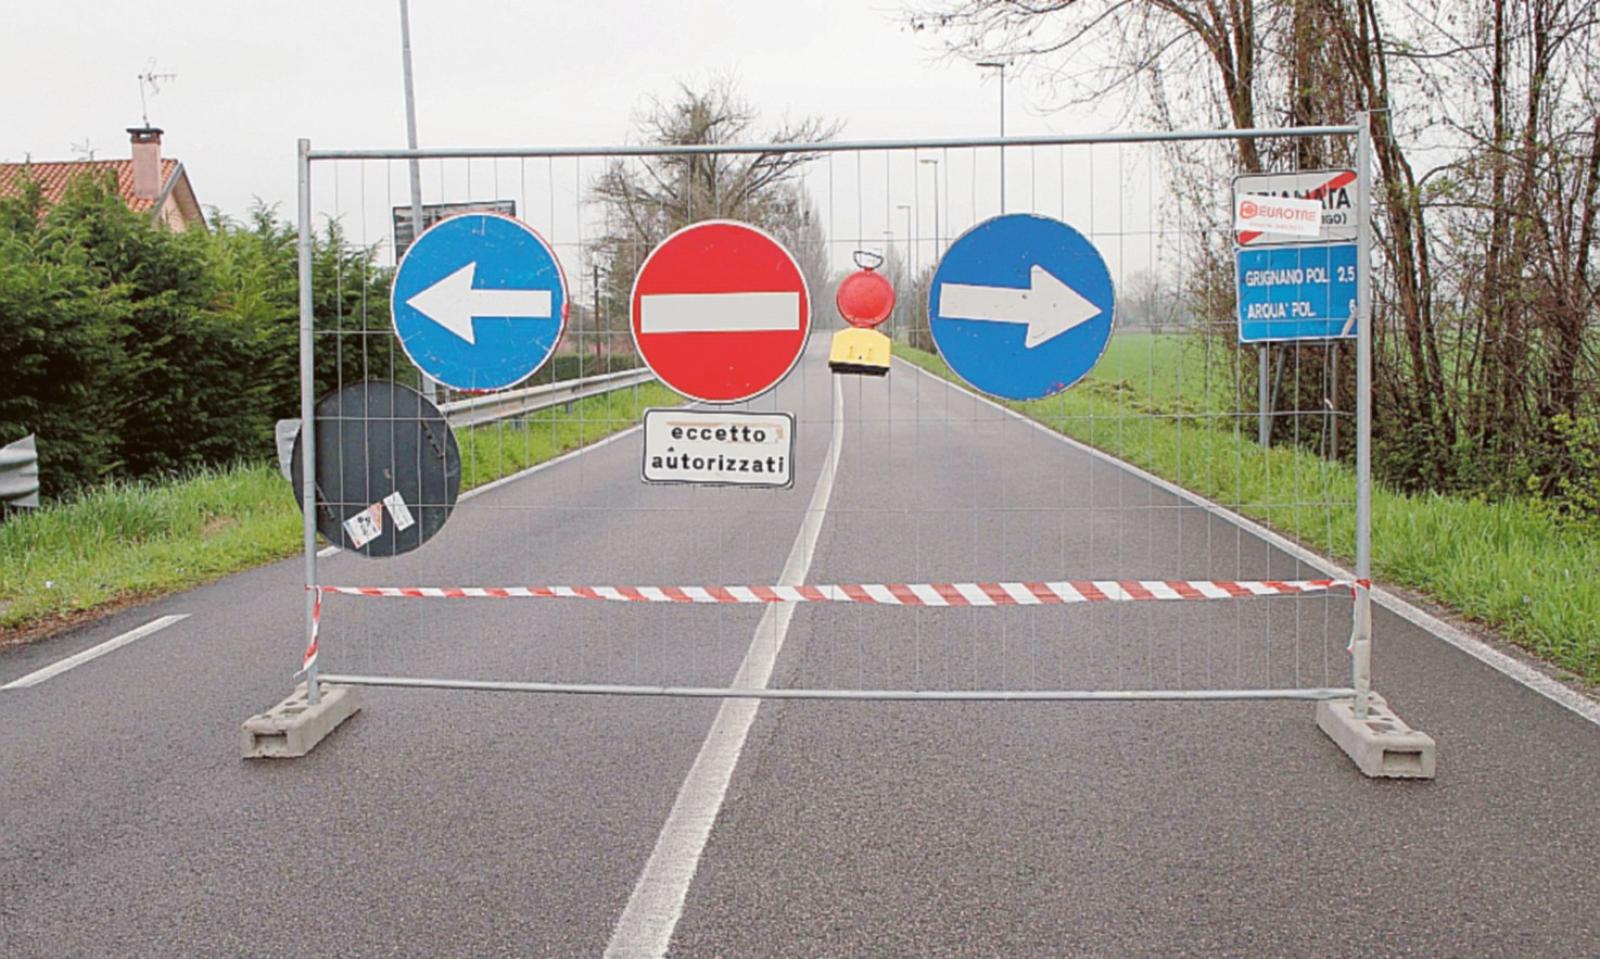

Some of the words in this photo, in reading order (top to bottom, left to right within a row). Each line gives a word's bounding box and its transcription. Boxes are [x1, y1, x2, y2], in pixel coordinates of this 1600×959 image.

[1245, 268, 1304, 287] GRIGNANO
[1337, 265, 1356, 284] 2,5
[1291, 300, 1318, 317] POL.
[671, 425, 767, 443] eccetto
[651, 453, 785, 474] autorizzati
